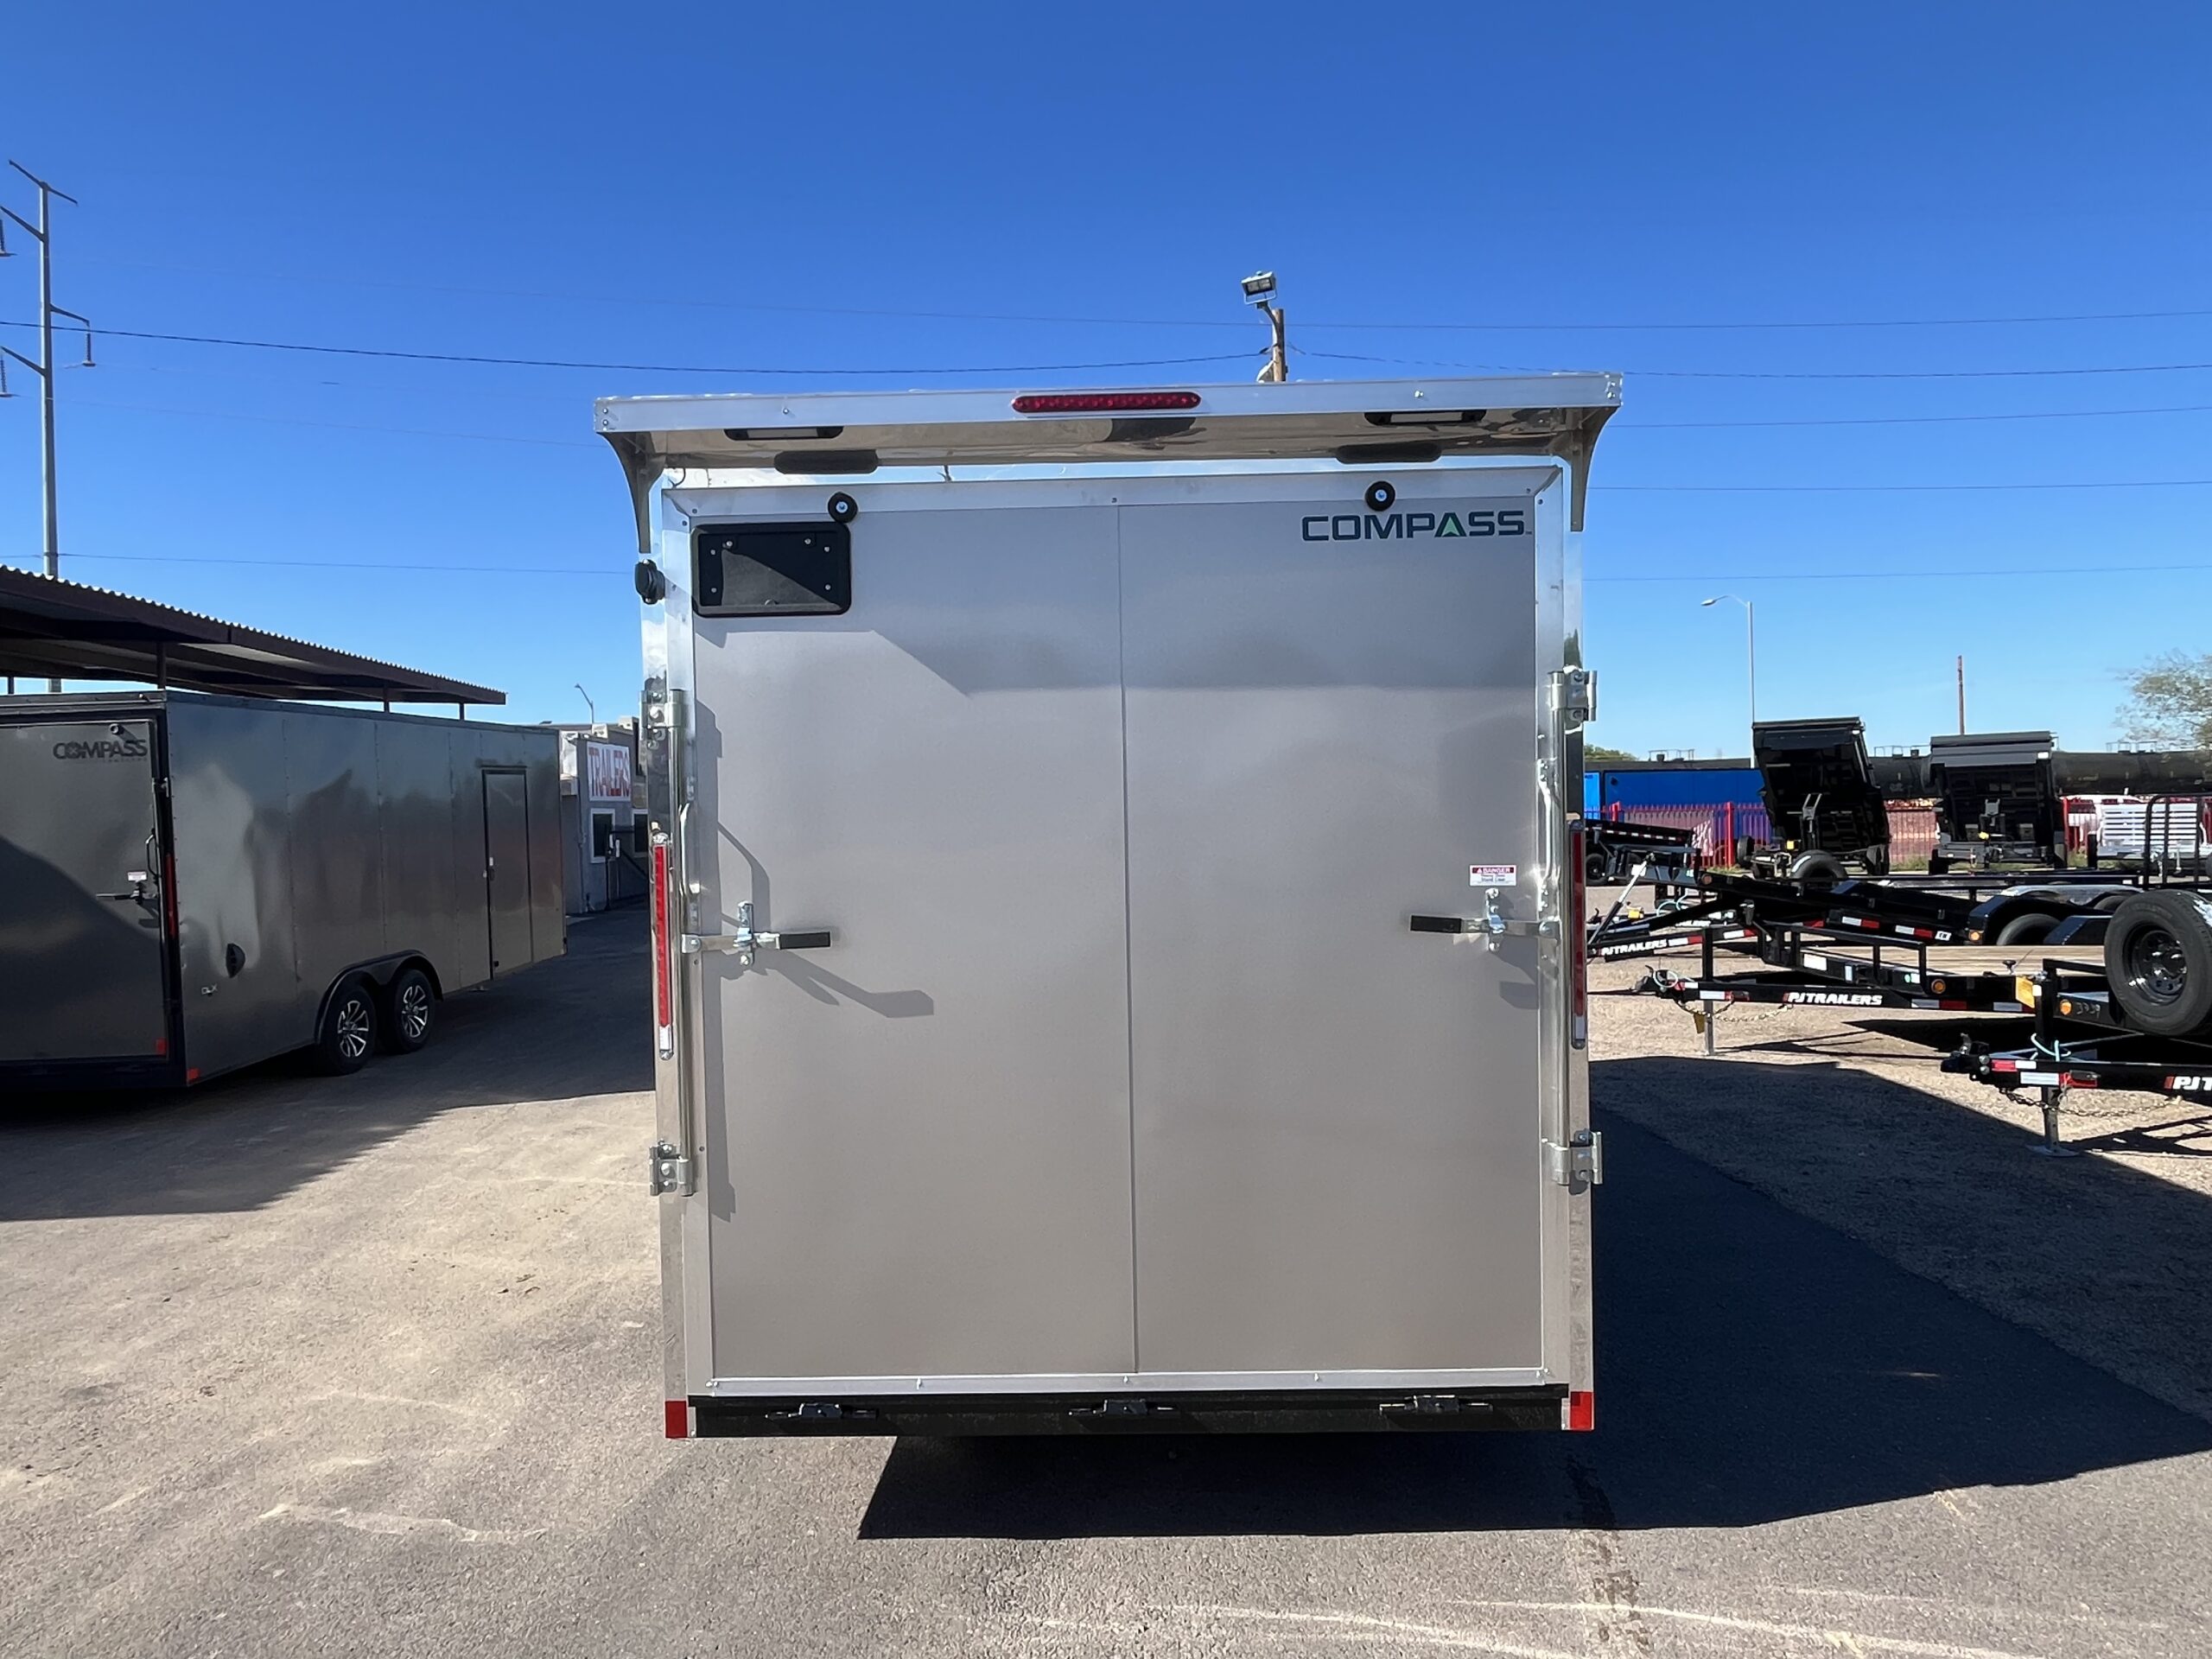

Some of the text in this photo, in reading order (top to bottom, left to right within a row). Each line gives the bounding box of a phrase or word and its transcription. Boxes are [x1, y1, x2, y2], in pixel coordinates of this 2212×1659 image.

[1301, 511, 1525, 542] COMPASS
[53, 739, 148, 760] COMPASS
[588, 747, 631, 797] TRAILERS
